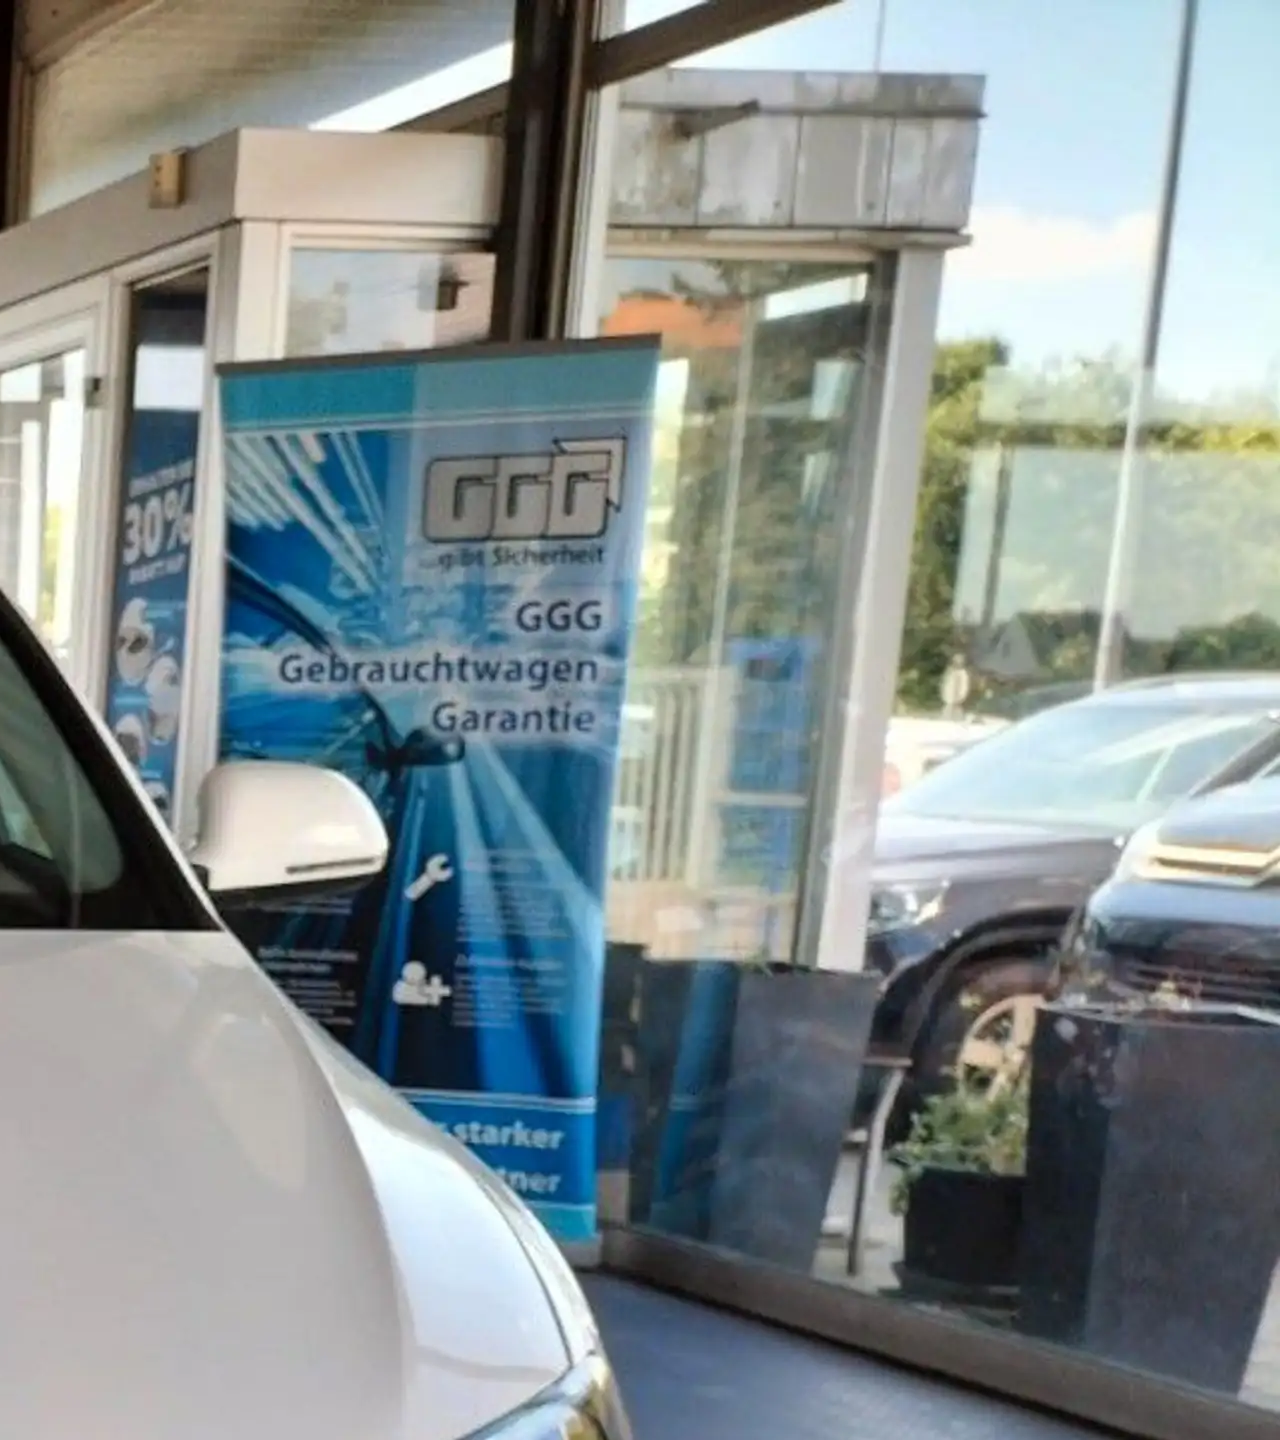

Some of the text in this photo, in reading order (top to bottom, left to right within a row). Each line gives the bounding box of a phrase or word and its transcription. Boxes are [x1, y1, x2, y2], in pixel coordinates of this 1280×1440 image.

[122, 482, 193, 566] 30%
[491, 546, 605, 566] Sicherheit
[515, 600, 602, 632] GGG
[278, 652, 599, 691] Gebrauchtwagen
[431, 702, 596, 735] Garantie
[453, 1120, 565, 1150] starker
